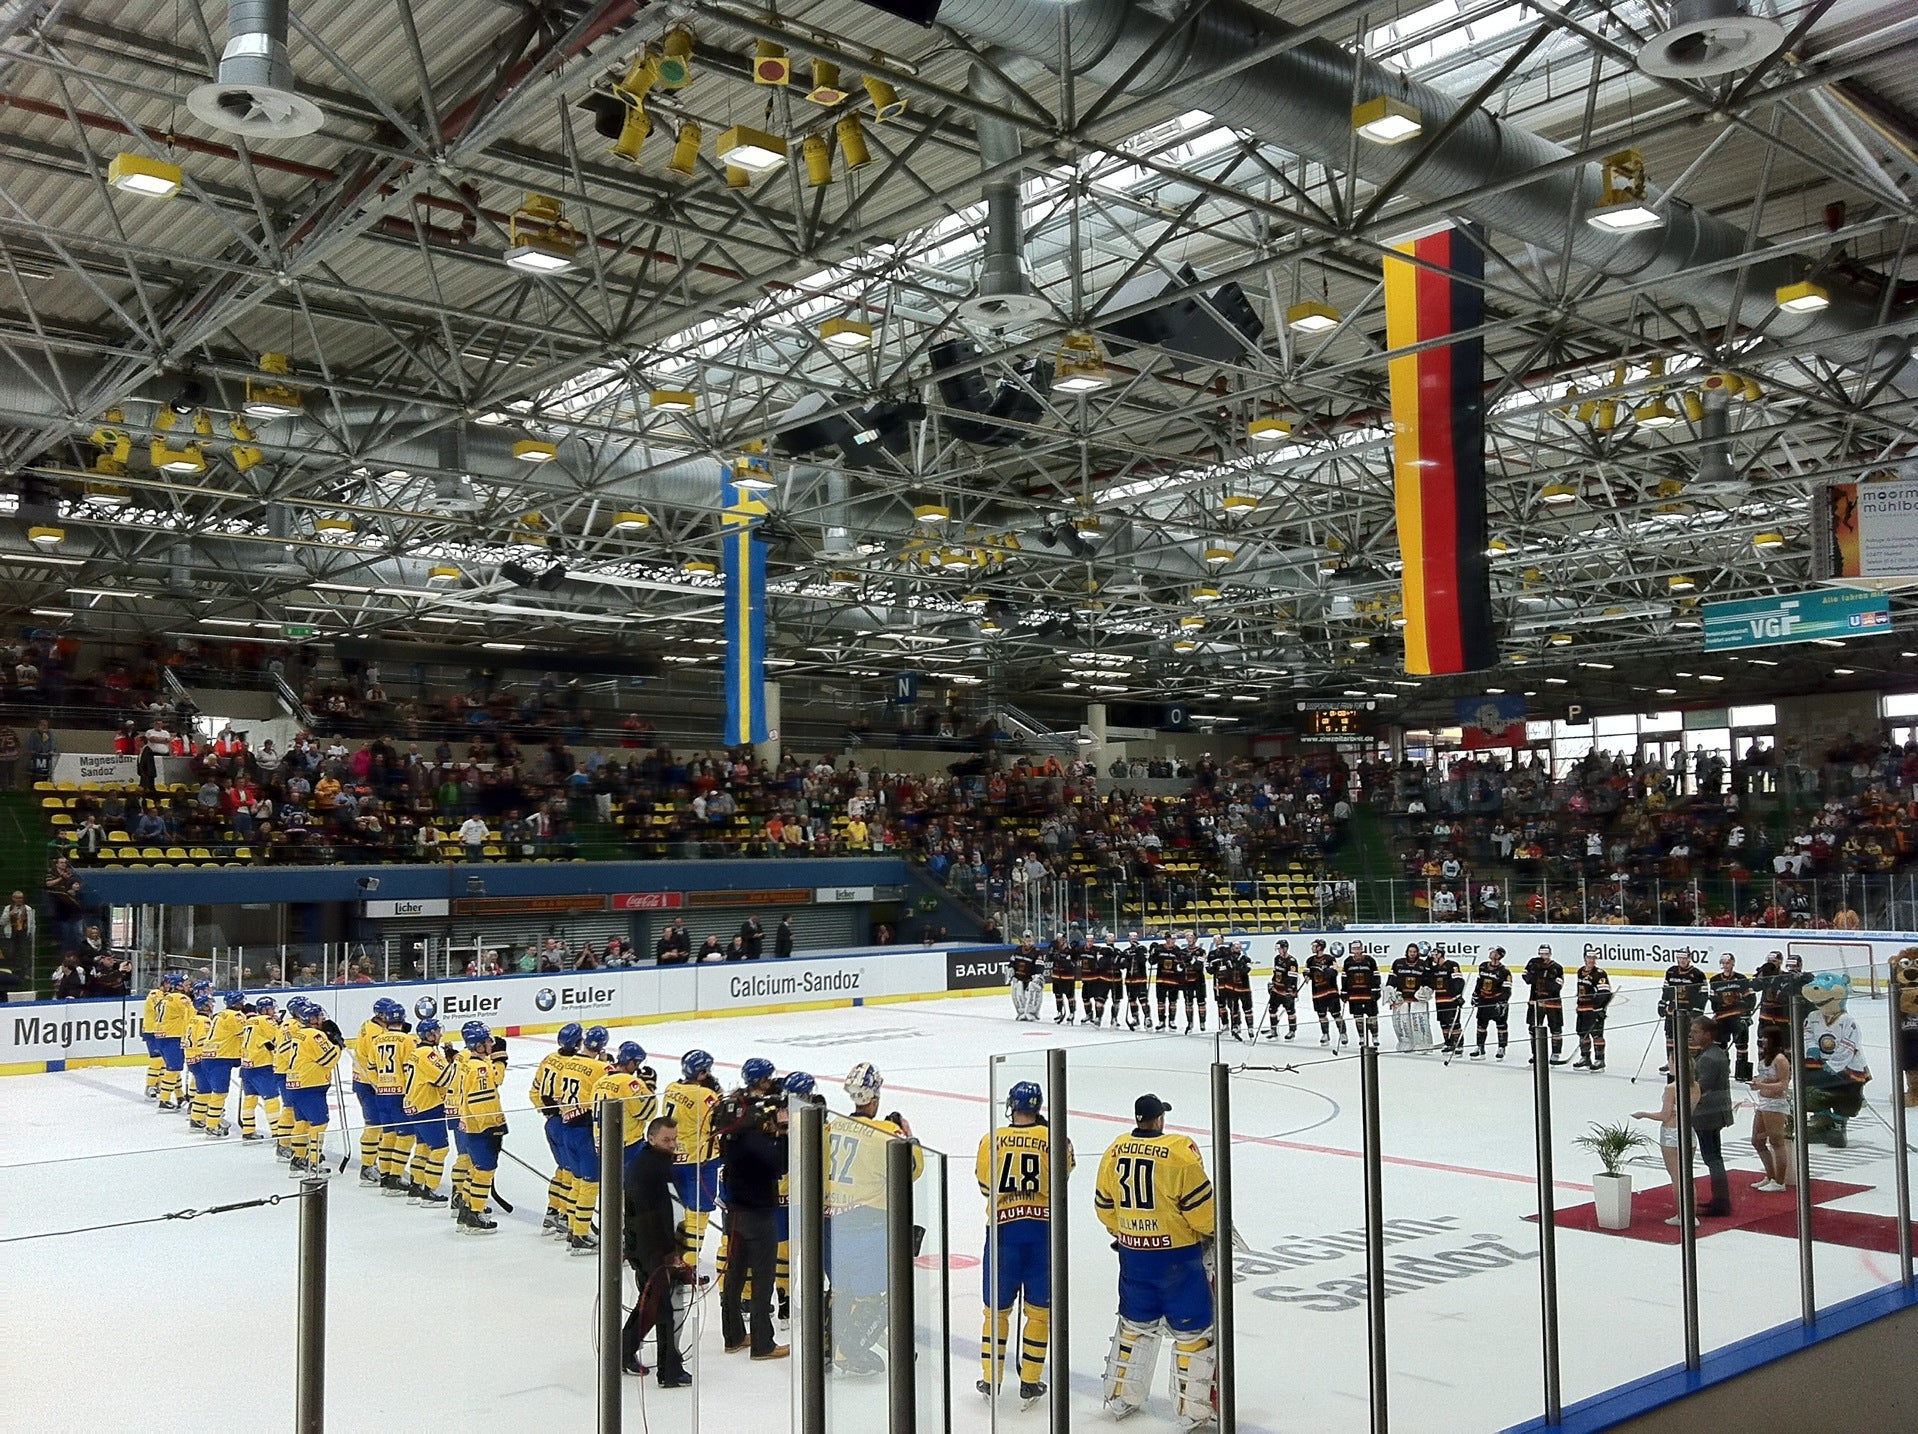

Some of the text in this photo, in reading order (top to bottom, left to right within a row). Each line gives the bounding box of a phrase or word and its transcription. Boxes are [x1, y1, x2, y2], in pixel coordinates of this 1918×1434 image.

[1750, 614, 1800, 639] VGF
[1850, 614, 1861, 627] U
[899, 678, 909, 694] N
[1568, 705, 1582, 721] P
[36, 758, 47, 769] M
[81, 767, 114, 777] Sandoz
[395, 902, 422, 915] Licher
[1583, 943, 1709, 964] Calcium-Saoz
[730, 972, 860, 997] Calcium-Sandoz
[443, 995, 503, 1013] Euler
[561, 986, 616, 1004] Euler
[998, 1152, 1040, 1193] 48
[1116, 1157, 1154, 1210] 30
[998, 1206, 1049, 1221] AUHAUS
[1232, 1215, 1460, 1284] alcium-
